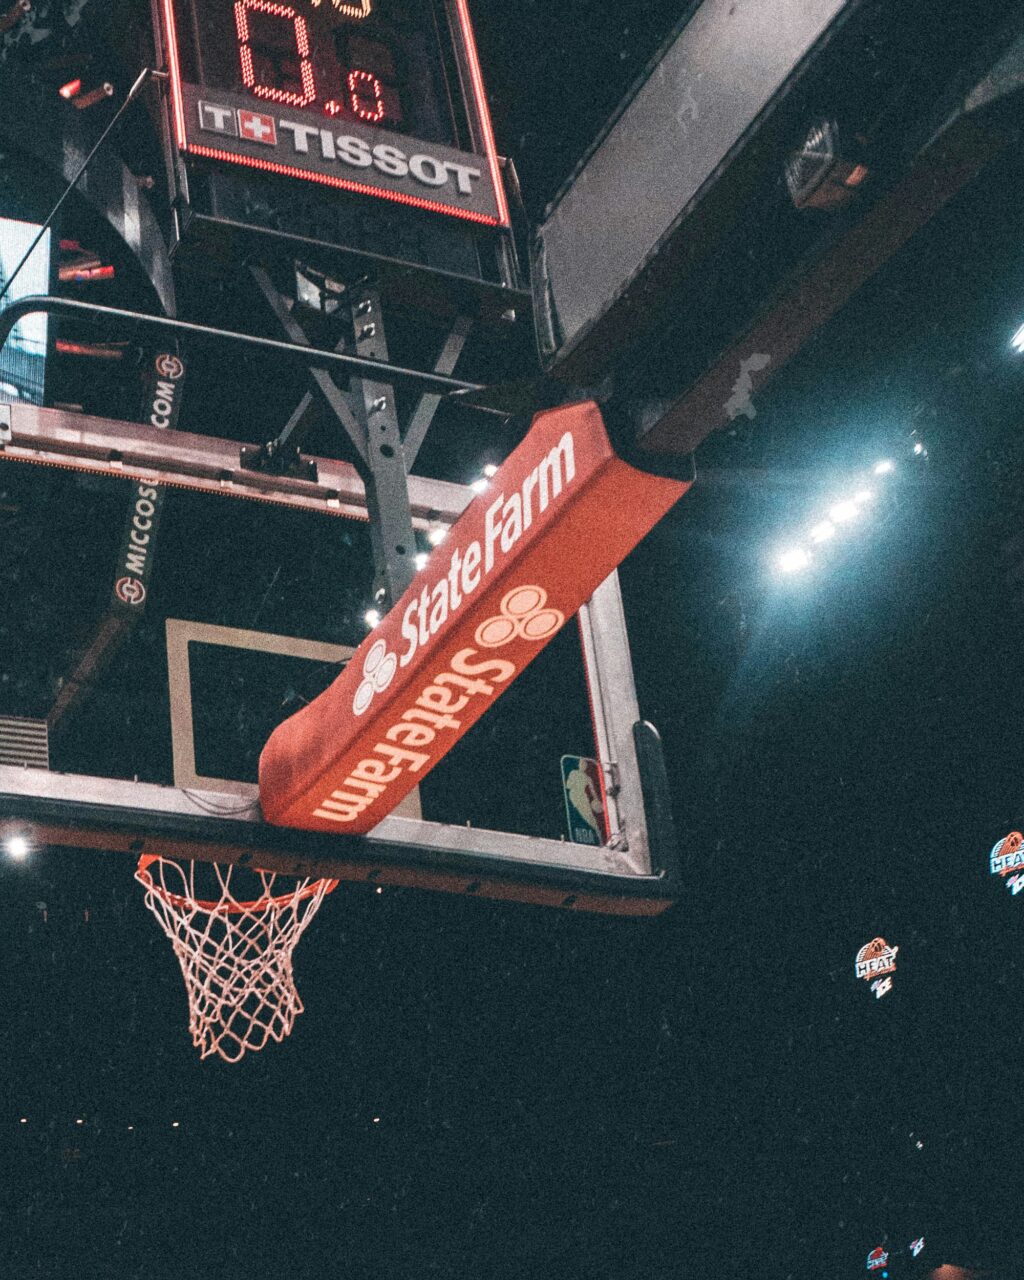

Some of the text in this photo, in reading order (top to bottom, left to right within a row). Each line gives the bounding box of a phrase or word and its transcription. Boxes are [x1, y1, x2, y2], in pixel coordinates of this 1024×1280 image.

[279, 119, 481, 196] TISSOT
[989, 849, 1024, 875] HEA
[855, 946, 899, 978] HEAT
